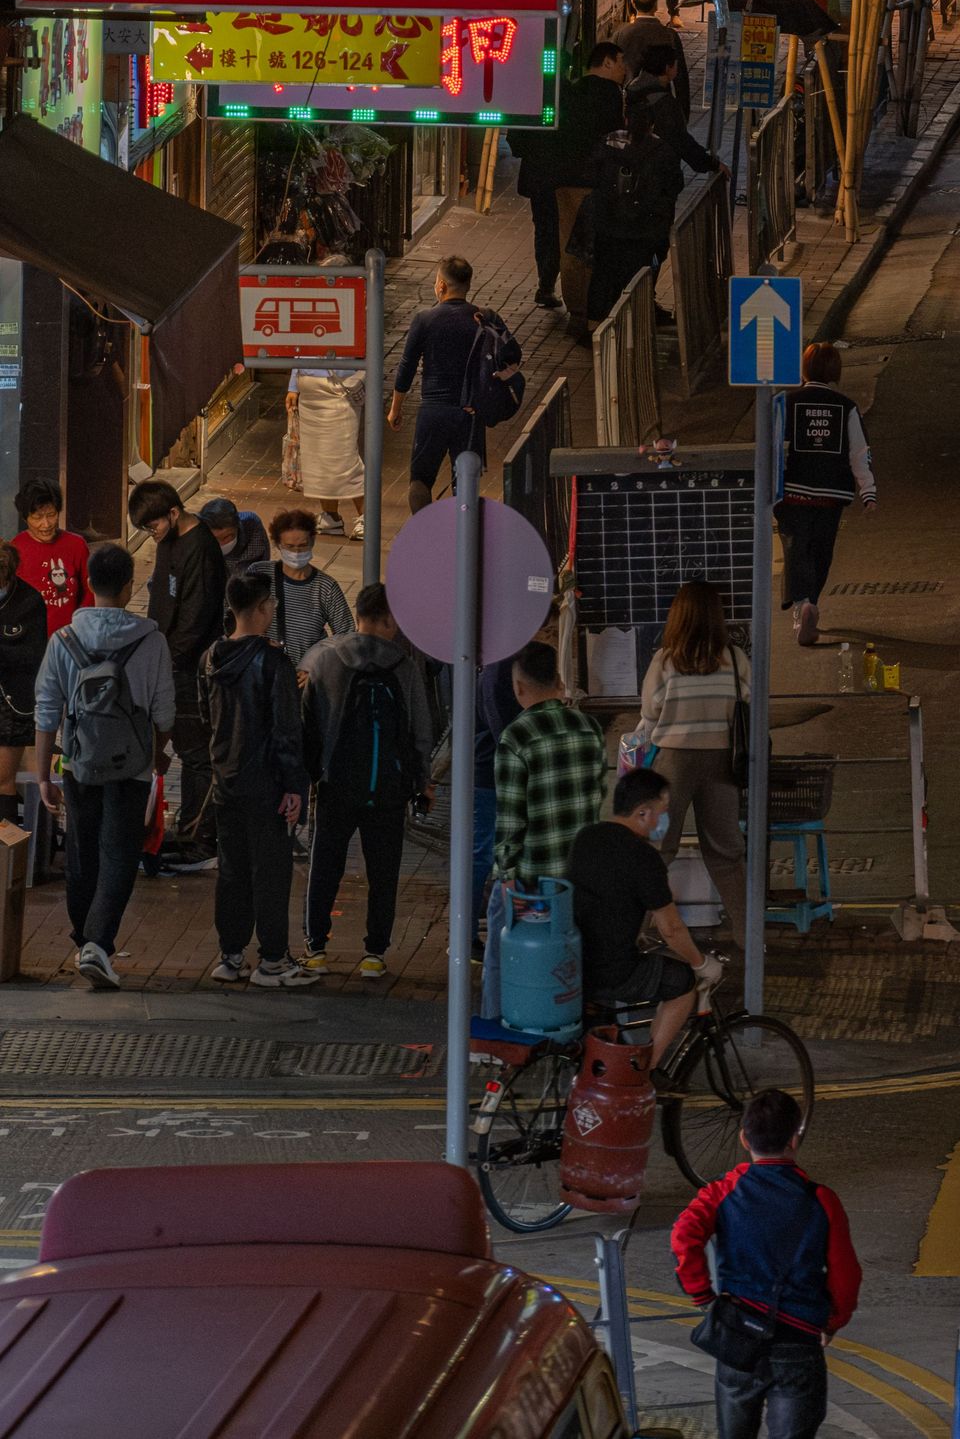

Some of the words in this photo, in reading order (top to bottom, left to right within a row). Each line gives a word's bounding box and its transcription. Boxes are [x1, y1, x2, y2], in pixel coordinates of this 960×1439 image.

[805, 409, 833, 417] REBEL
[809, 419, 829, 427] AND
[806, 428, 831, 437] LOUD
[610, 481, 619, 491] 2
[635, 480, 644, 490] 3
[659, 479, 668, 489] 4
[687, 478, 695, 488] 5
[710, 478, 719, 488] 6
[737, 477, 745, 487] 7
